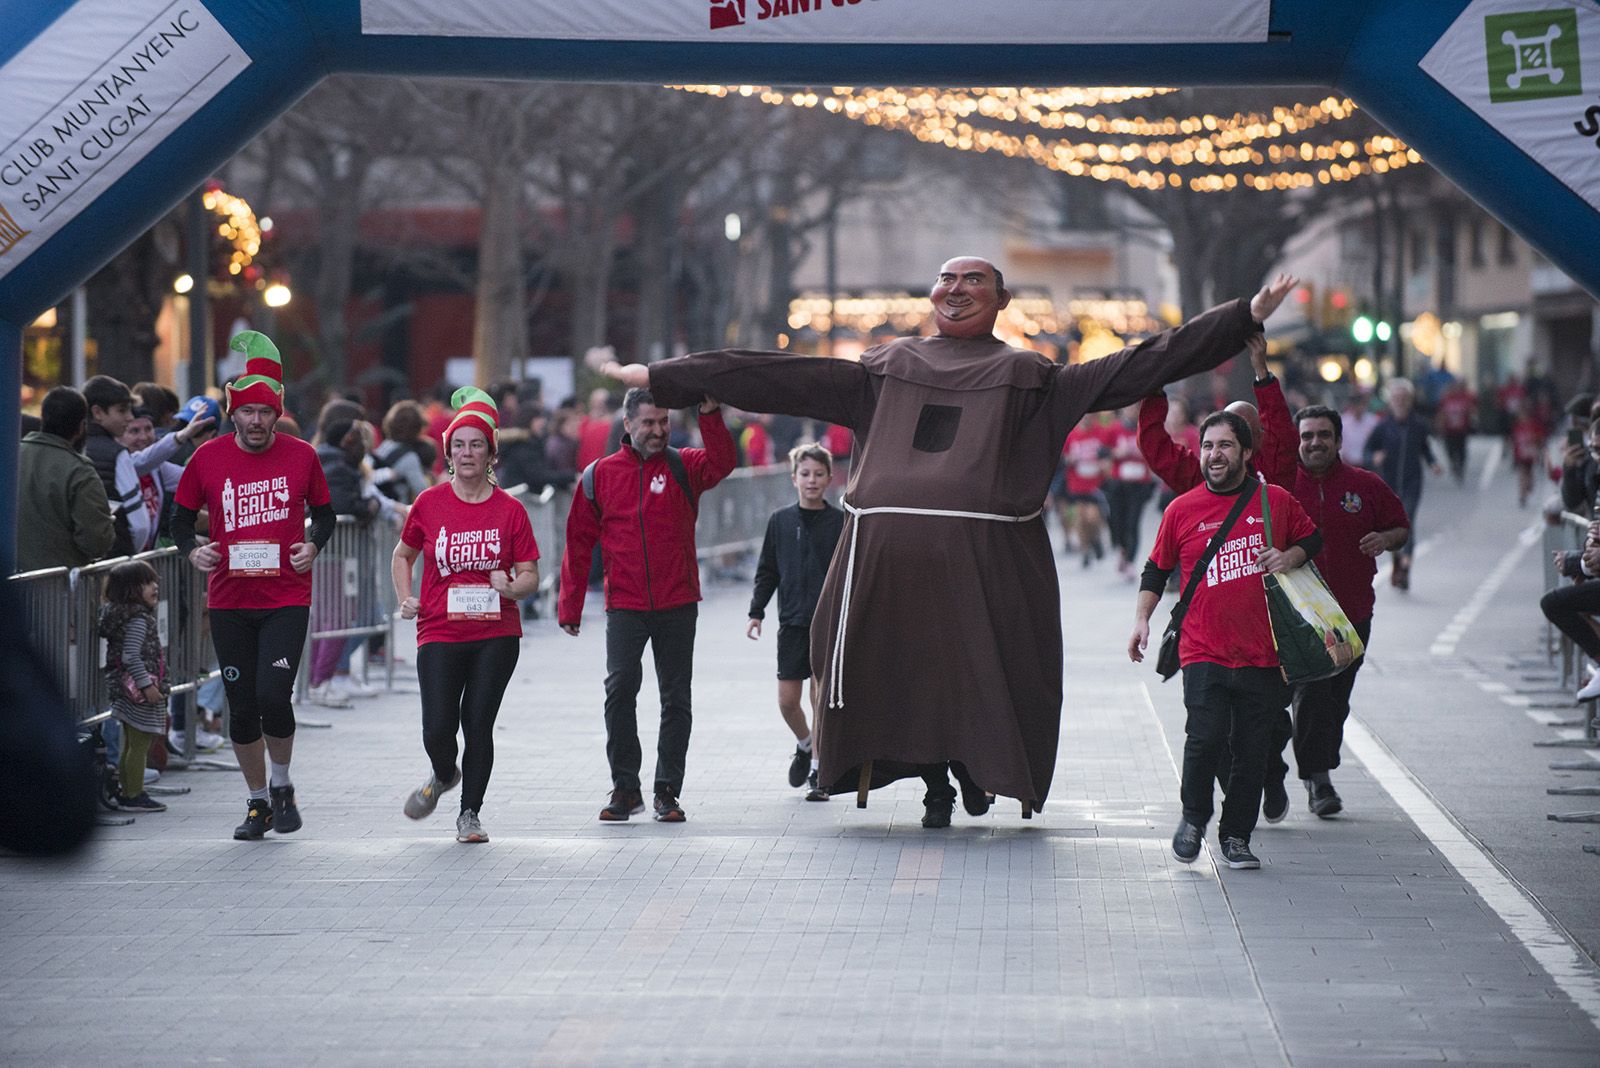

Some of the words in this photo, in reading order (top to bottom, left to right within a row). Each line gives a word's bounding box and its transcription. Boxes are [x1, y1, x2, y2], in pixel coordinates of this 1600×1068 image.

[1, 138, 55, 187] CLUB
[53, 9, 200, 145] MUNTANYENC
[22, 156, 81, 212] SANT
[80, 94, 152, 161] CUGAT
[238, 480, 270, 496] CURSA
[272, 476, 289, 489] DEL
[238, 492, 276, 515] GALL
[238, 514, 261, 528] SANT
[262, 508, 290, 523] CUGAT
[451, 530, 482, 545] CURSA
[485, 528, 500, 542] DEL
[1249, 533, 1263, 547] DEL
[239, 552, 269, 560] SERGIO
[450, 544, 489, 563] GALL
[1220, 549, 1254, 571] GALL
[245, 560, 262, 568] 638
[473, 559, 501, 571] CUGAT
[1220, 567, 1242, 582] SANT
[456, 595, 493, 603] REBECCA
